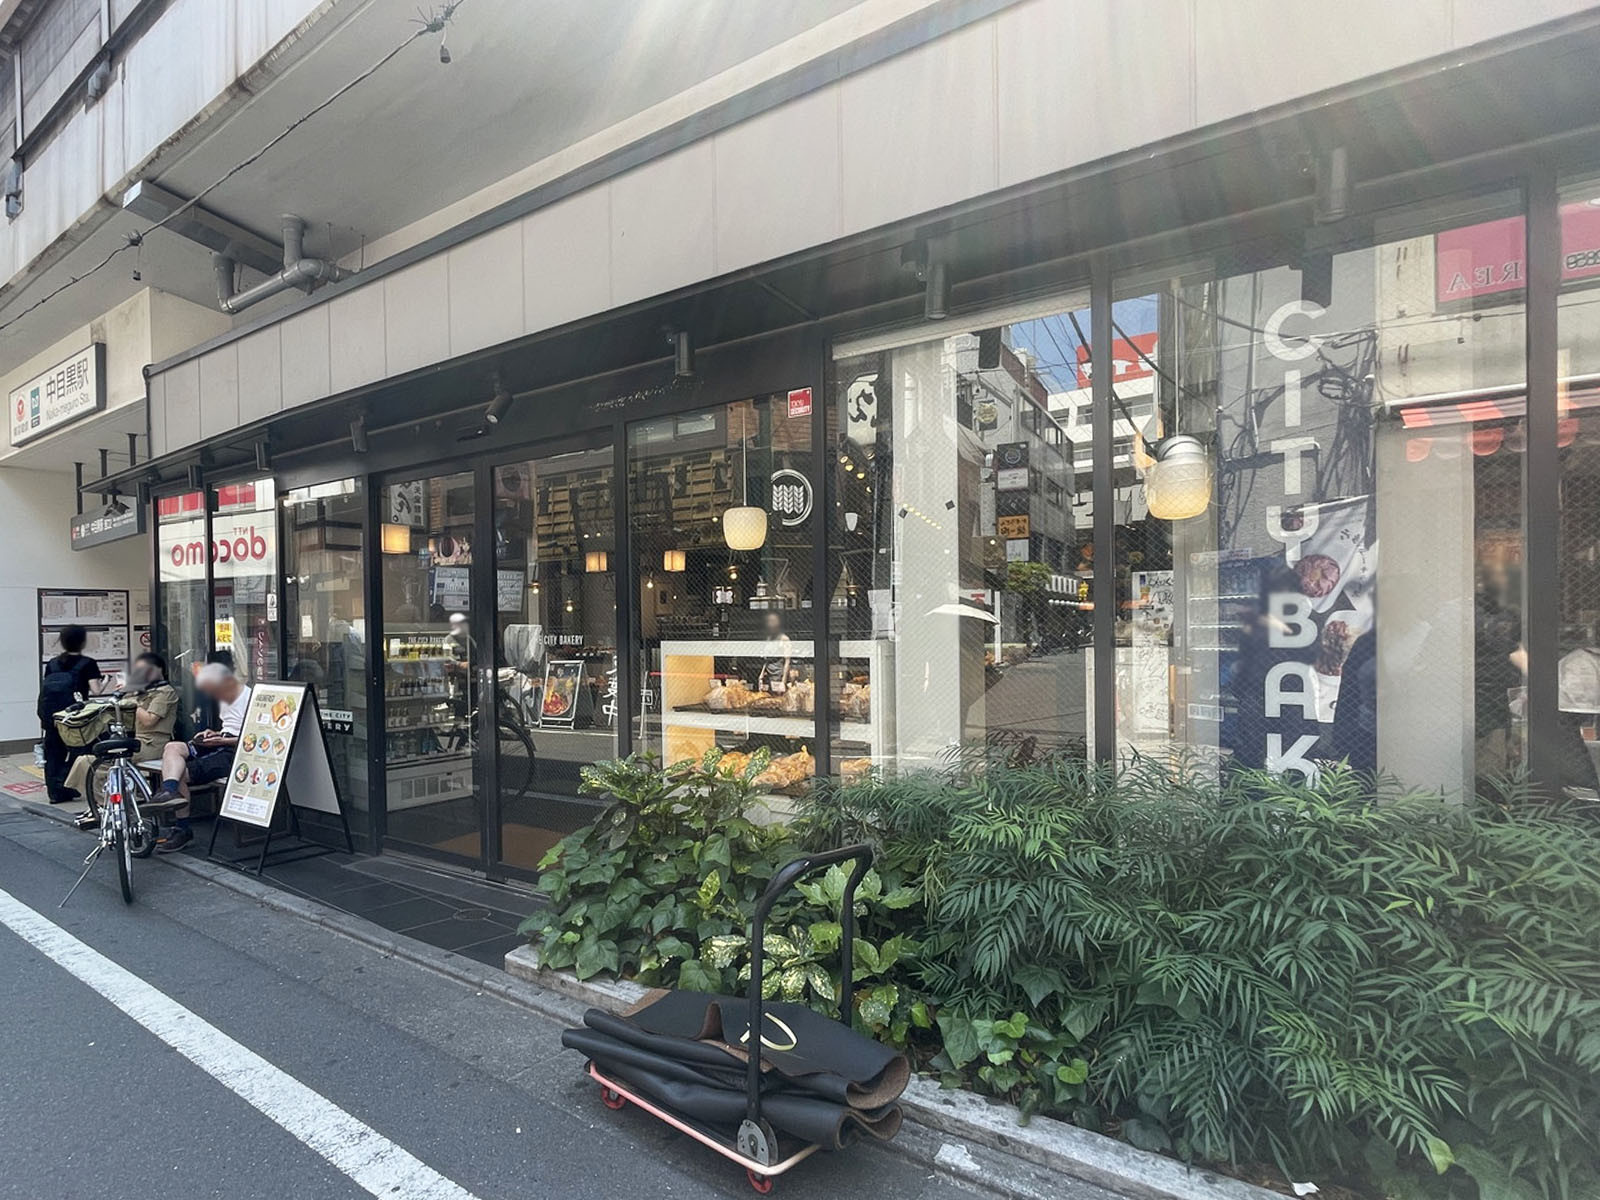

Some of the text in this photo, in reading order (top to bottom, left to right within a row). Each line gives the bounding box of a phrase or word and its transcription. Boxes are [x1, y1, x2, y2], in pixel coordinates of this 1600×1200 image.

[46, 357, 90, 404] 中目黒駅
[46, 391, 91, 421] Naka-meguro Sta.
[1262, 298, 1327, 568] CITY
[543, 634, 557, 646] CITY
[558, 634, 584, 646] BAKERY
[322, 721, 351, 732] ERY
